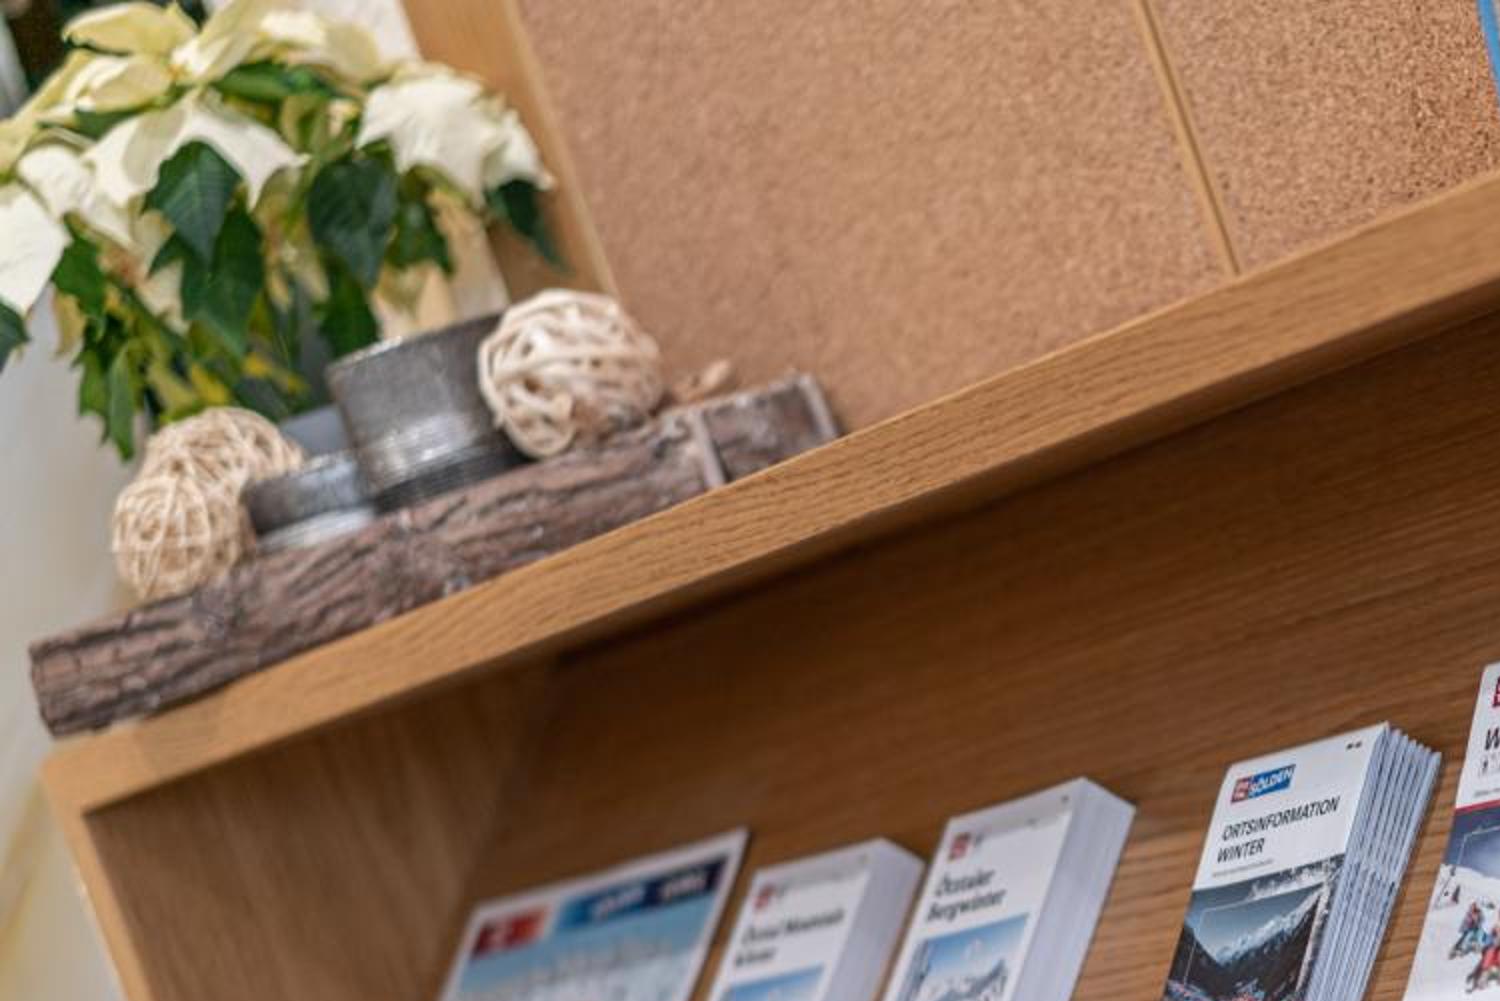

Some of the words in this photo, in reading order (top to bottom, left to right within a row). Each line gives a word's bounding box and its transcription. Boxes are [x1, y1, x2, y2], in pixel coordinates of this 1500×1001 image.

[1251, 766, 1295, 793] SÖLDEN
[1222, 796, 1341, 841] ORTSINFORMATION
[1217, 838, 1265, 863] WINTER
